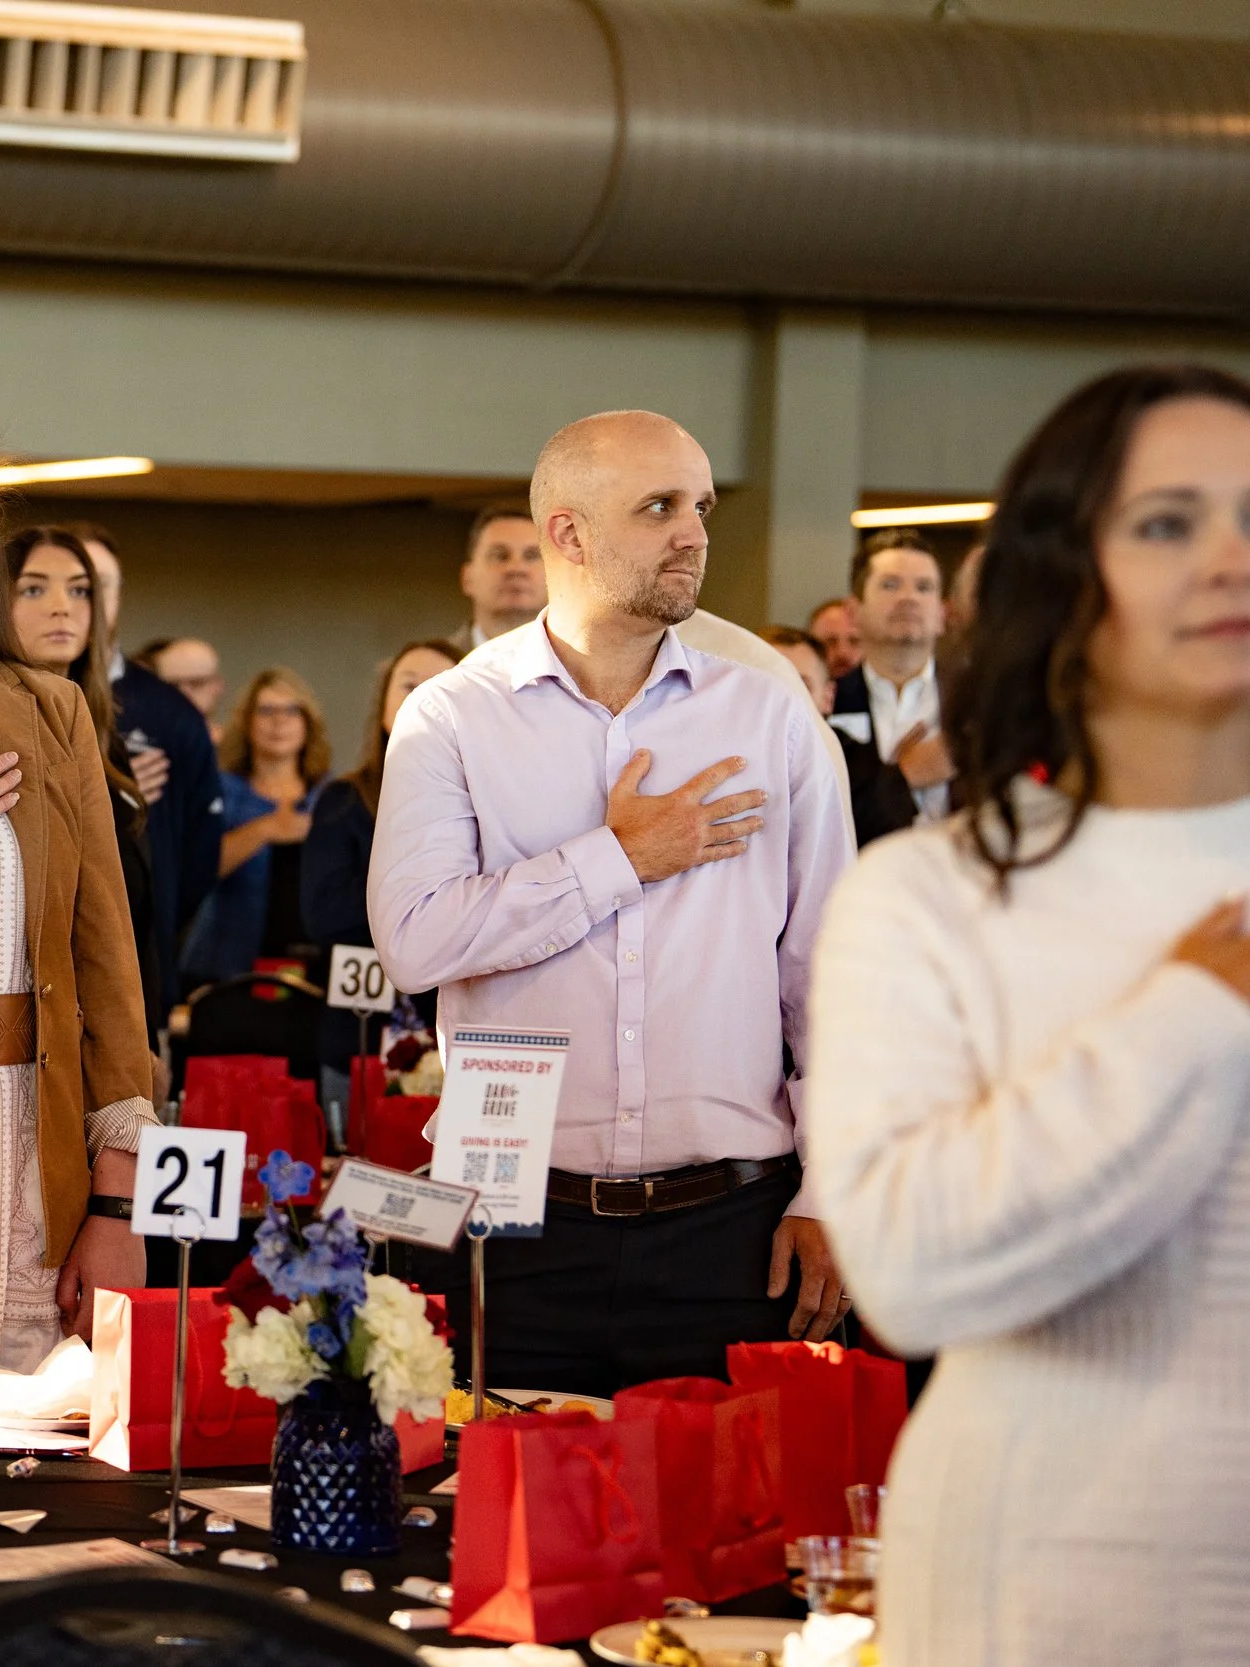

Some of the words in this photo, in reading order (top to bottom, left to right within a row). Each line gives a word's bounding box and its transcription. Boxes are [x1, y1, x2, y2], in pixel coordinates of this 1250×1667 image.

[340, 958, 385, 1000] 30
[461, 1059, 534, 1072] SPONSORED
[537, 1062, 552, 1073] BY
[461, 1137, 490, 1146] GIVING
[151, 1145, 226, 1218] 21
